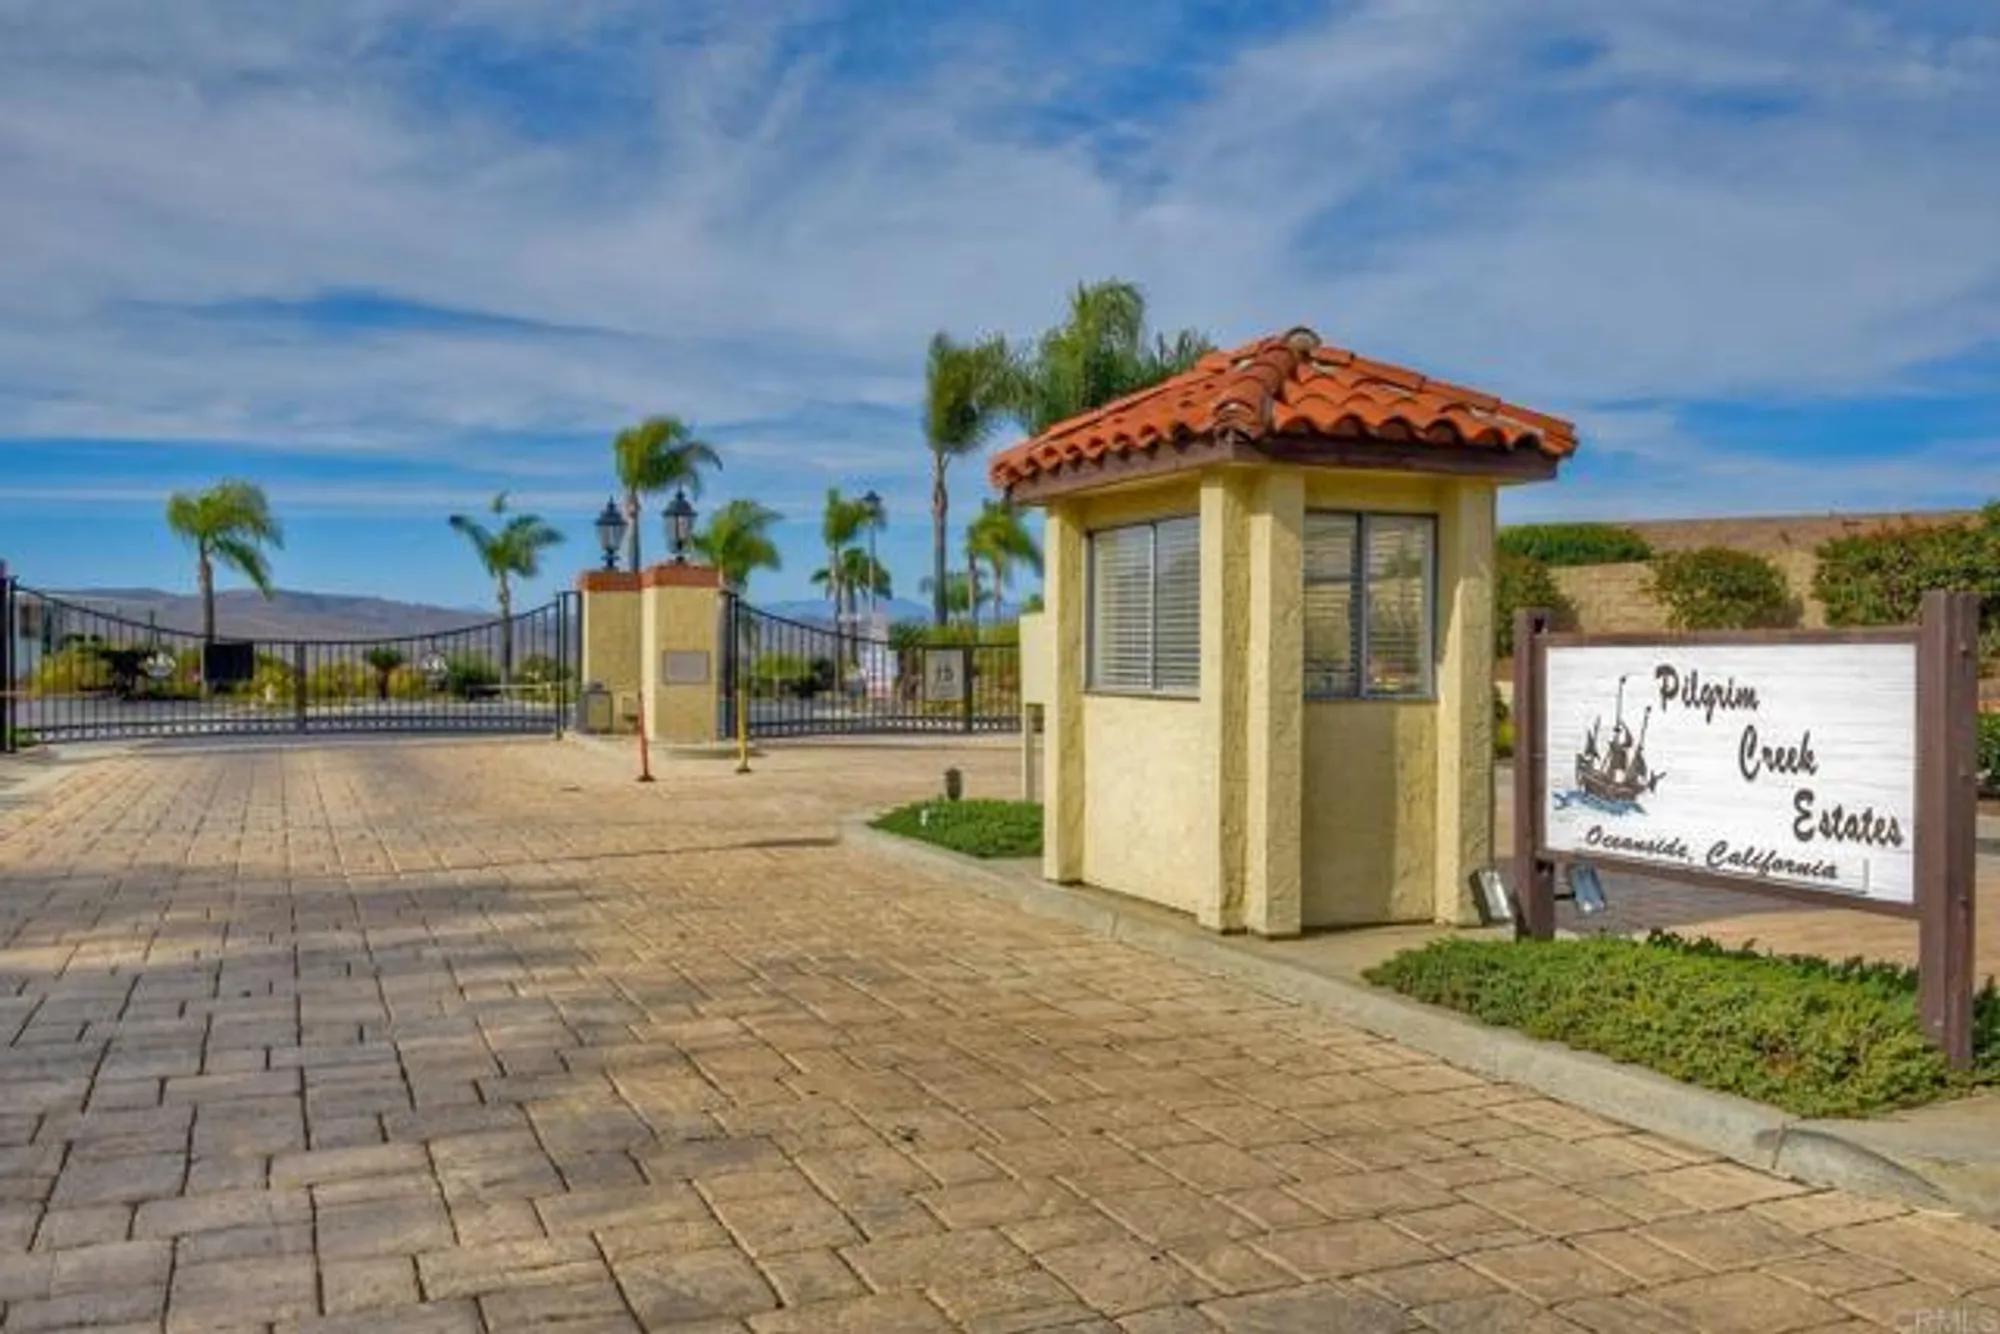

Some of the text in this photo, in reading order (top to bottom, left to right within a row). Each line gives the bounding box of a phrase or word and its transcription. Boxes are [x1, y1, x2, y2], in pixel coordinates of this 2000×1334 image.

[1655, 664, 1759, 722] Pilgrim
[1739, 725, 1819, 780] Creek
[1793, 789, 1902, 848] Estates
[1585, 825, 1839, 879] Oceanside, California
